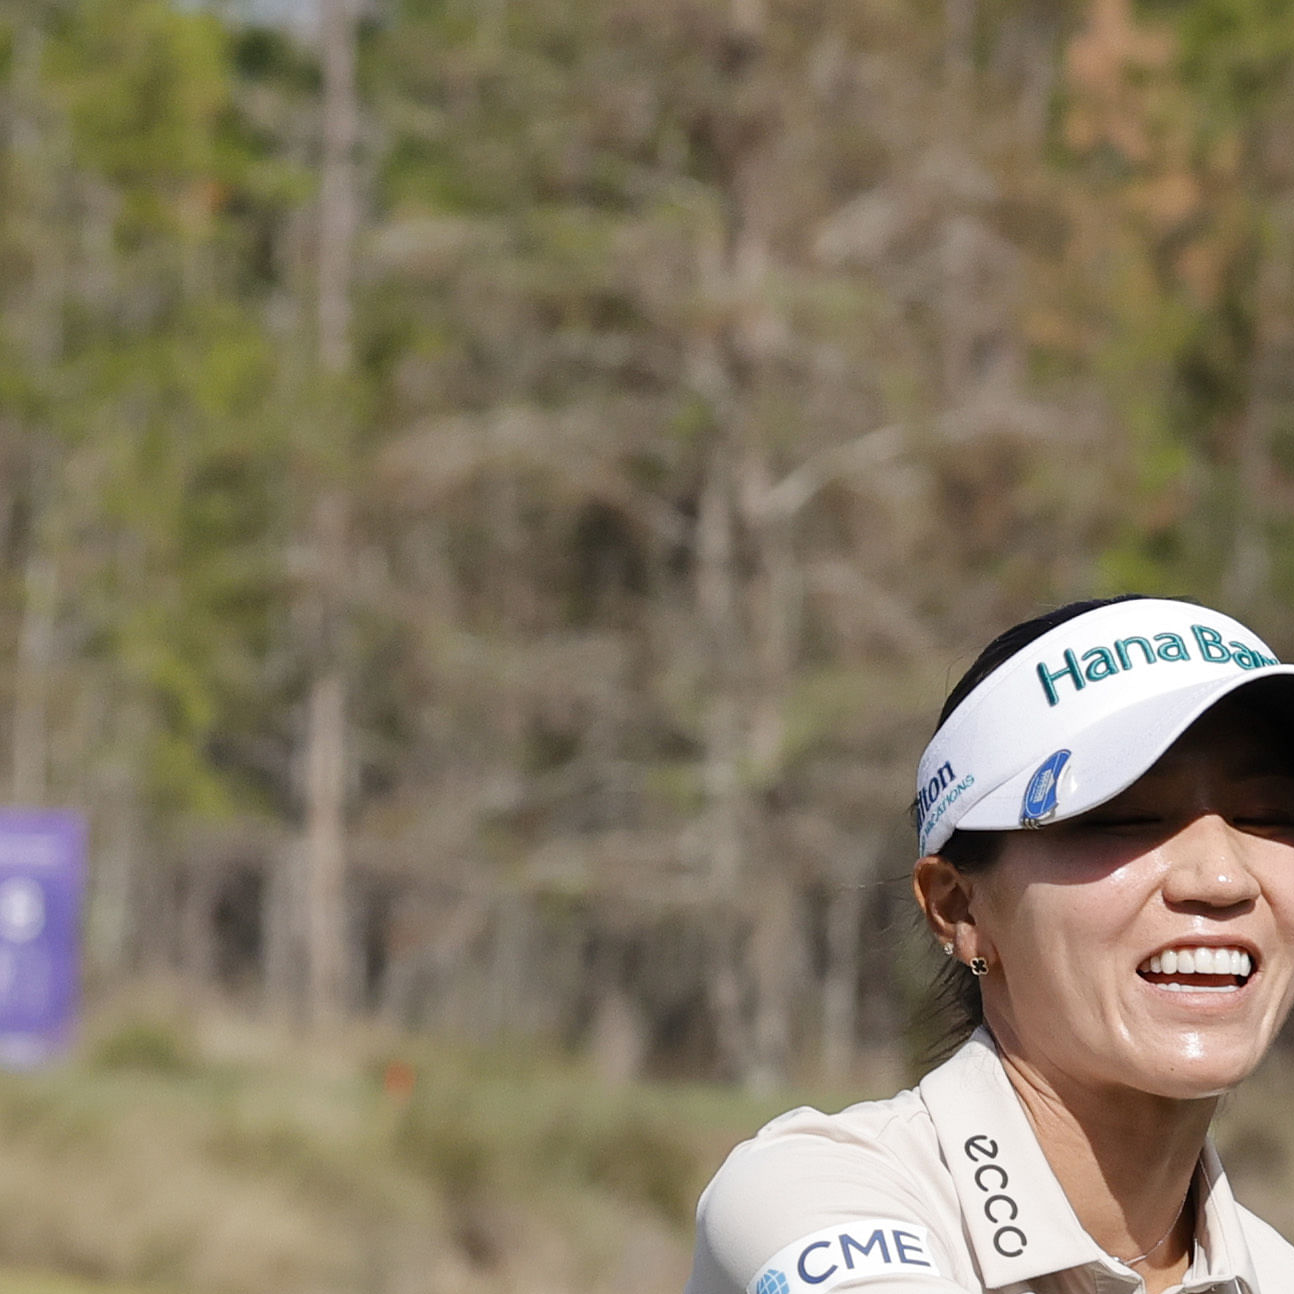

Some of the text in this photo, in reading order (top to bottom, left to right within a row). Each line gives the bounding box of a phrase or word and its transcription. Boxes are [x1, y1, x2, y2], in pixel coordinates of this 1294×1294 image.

[1036, 624, 1280, 707] Hana Ban
[964, 1134, 1027, 1258] ecco
[797, 1229, 931, 1285] CME
